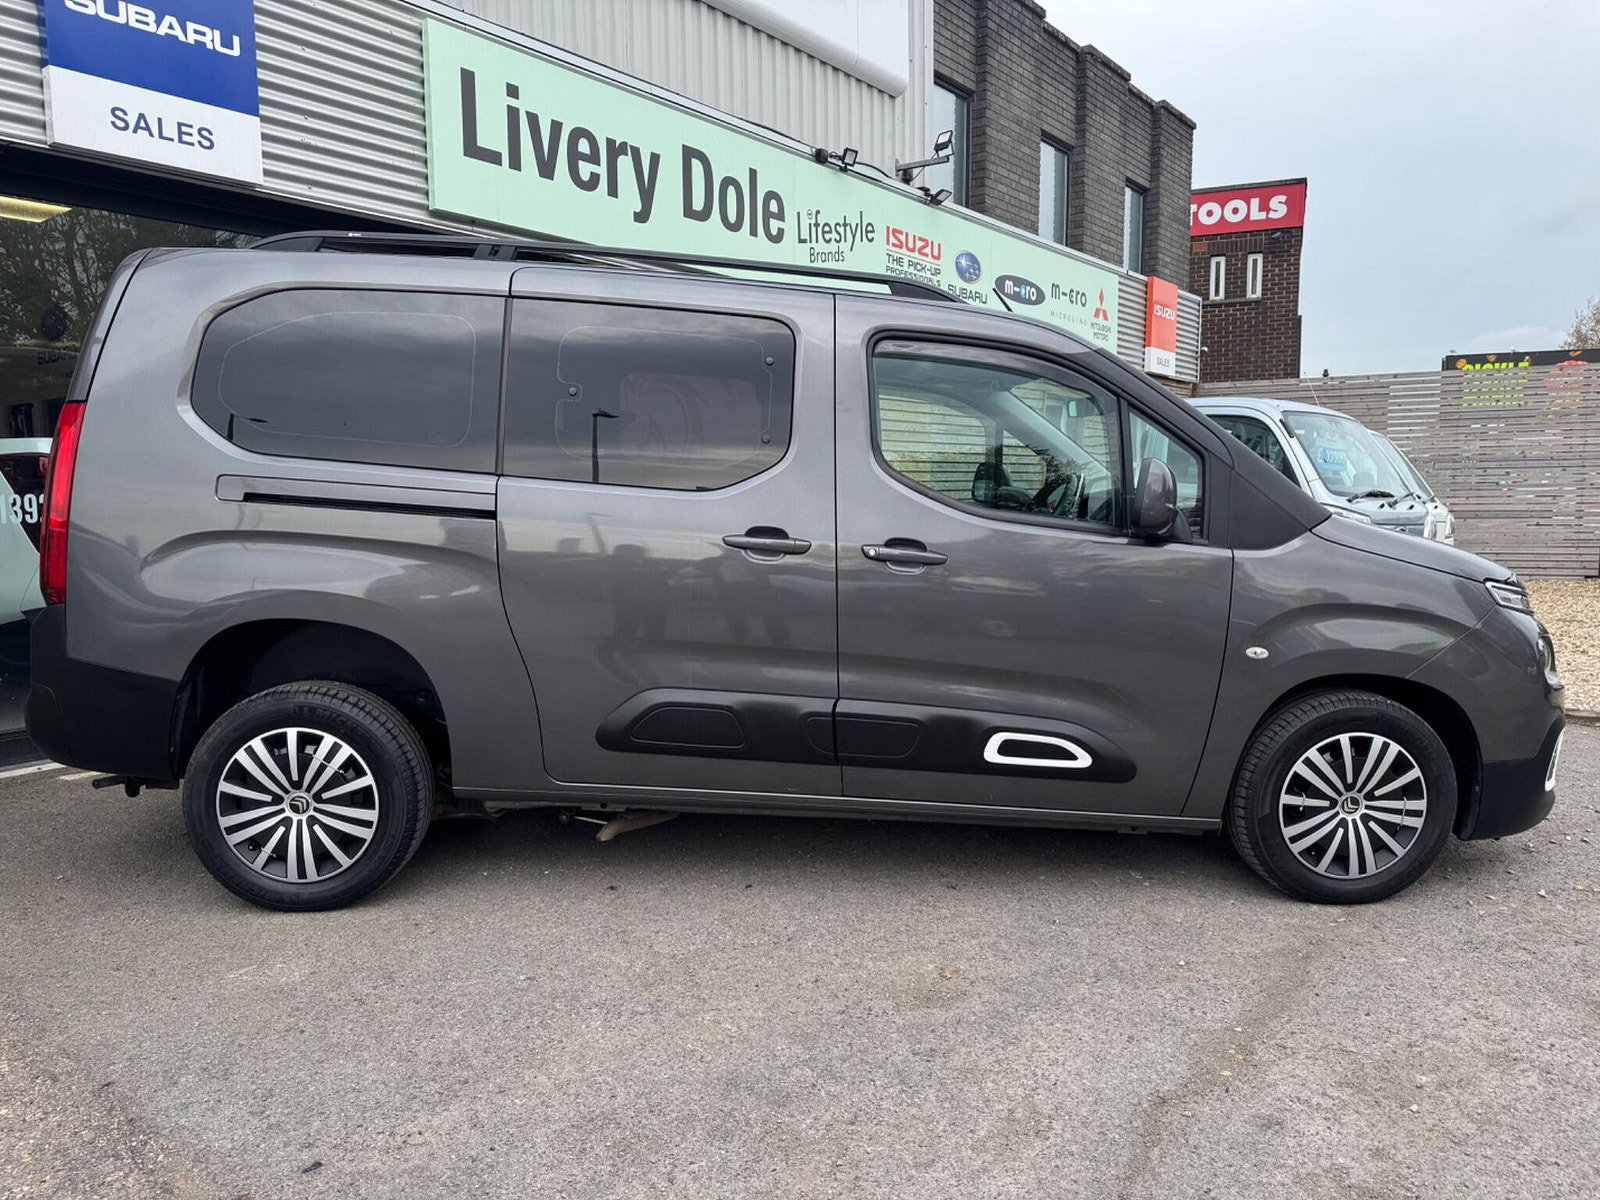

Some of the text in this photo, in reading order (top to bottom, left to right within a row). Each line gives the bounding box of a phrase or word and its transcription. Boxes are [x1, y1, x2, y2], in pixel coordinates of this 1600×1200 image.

[65, 0, 241, 57] SUBARU
[110, 106, 215, 150] SALES
[460, 66, 786, 244] Livery Dole
[797, 209, 875, 252] Lifestyle
[885, 225, 942, 261] ISUZU
[809, 245, 845, 264] Brands
[886, 253, 941, 278] THE PICK-UP
[947, 283, 988, 304] SUBARU
[1154, 303, 1176, 320] ISUZU
[1156, 356, 1170, 368] SALES
